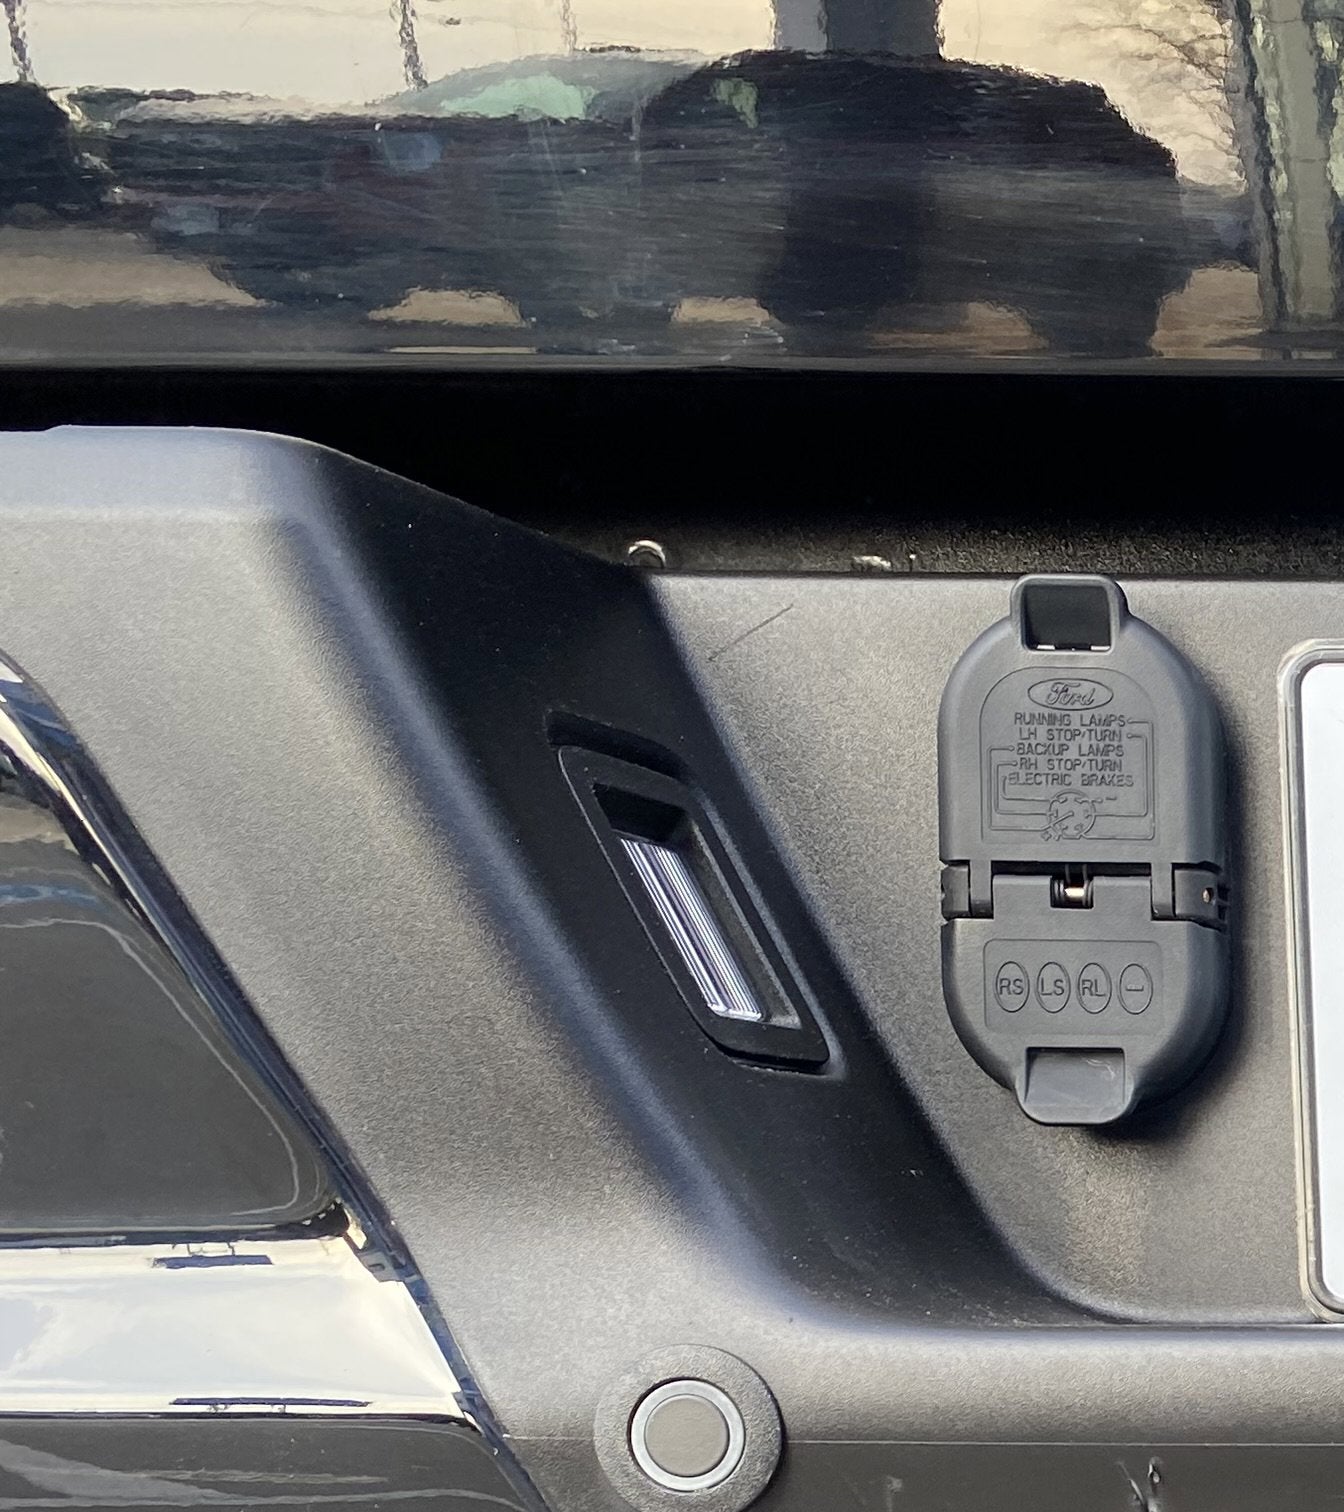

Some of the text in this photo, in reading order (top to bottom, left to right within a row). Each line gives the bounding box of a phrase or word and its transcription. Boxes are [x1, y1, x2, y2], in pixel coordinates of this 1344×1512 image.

[1045, 681, 1096, 706] Ford
[1014, 712, 1126, 728] RUNNING LAMPS
[1019, 726, 1123, 742] LH STOP/TURN
[1016, 742, 1125, 757] BACKUP LAMPS
[1019, 757, 1123, 772] RH STOP/TURN
[1008, 771, 1135, 788] ELECTRIC BRAKES
[999, 977, 1106, 997] RS LS RL
